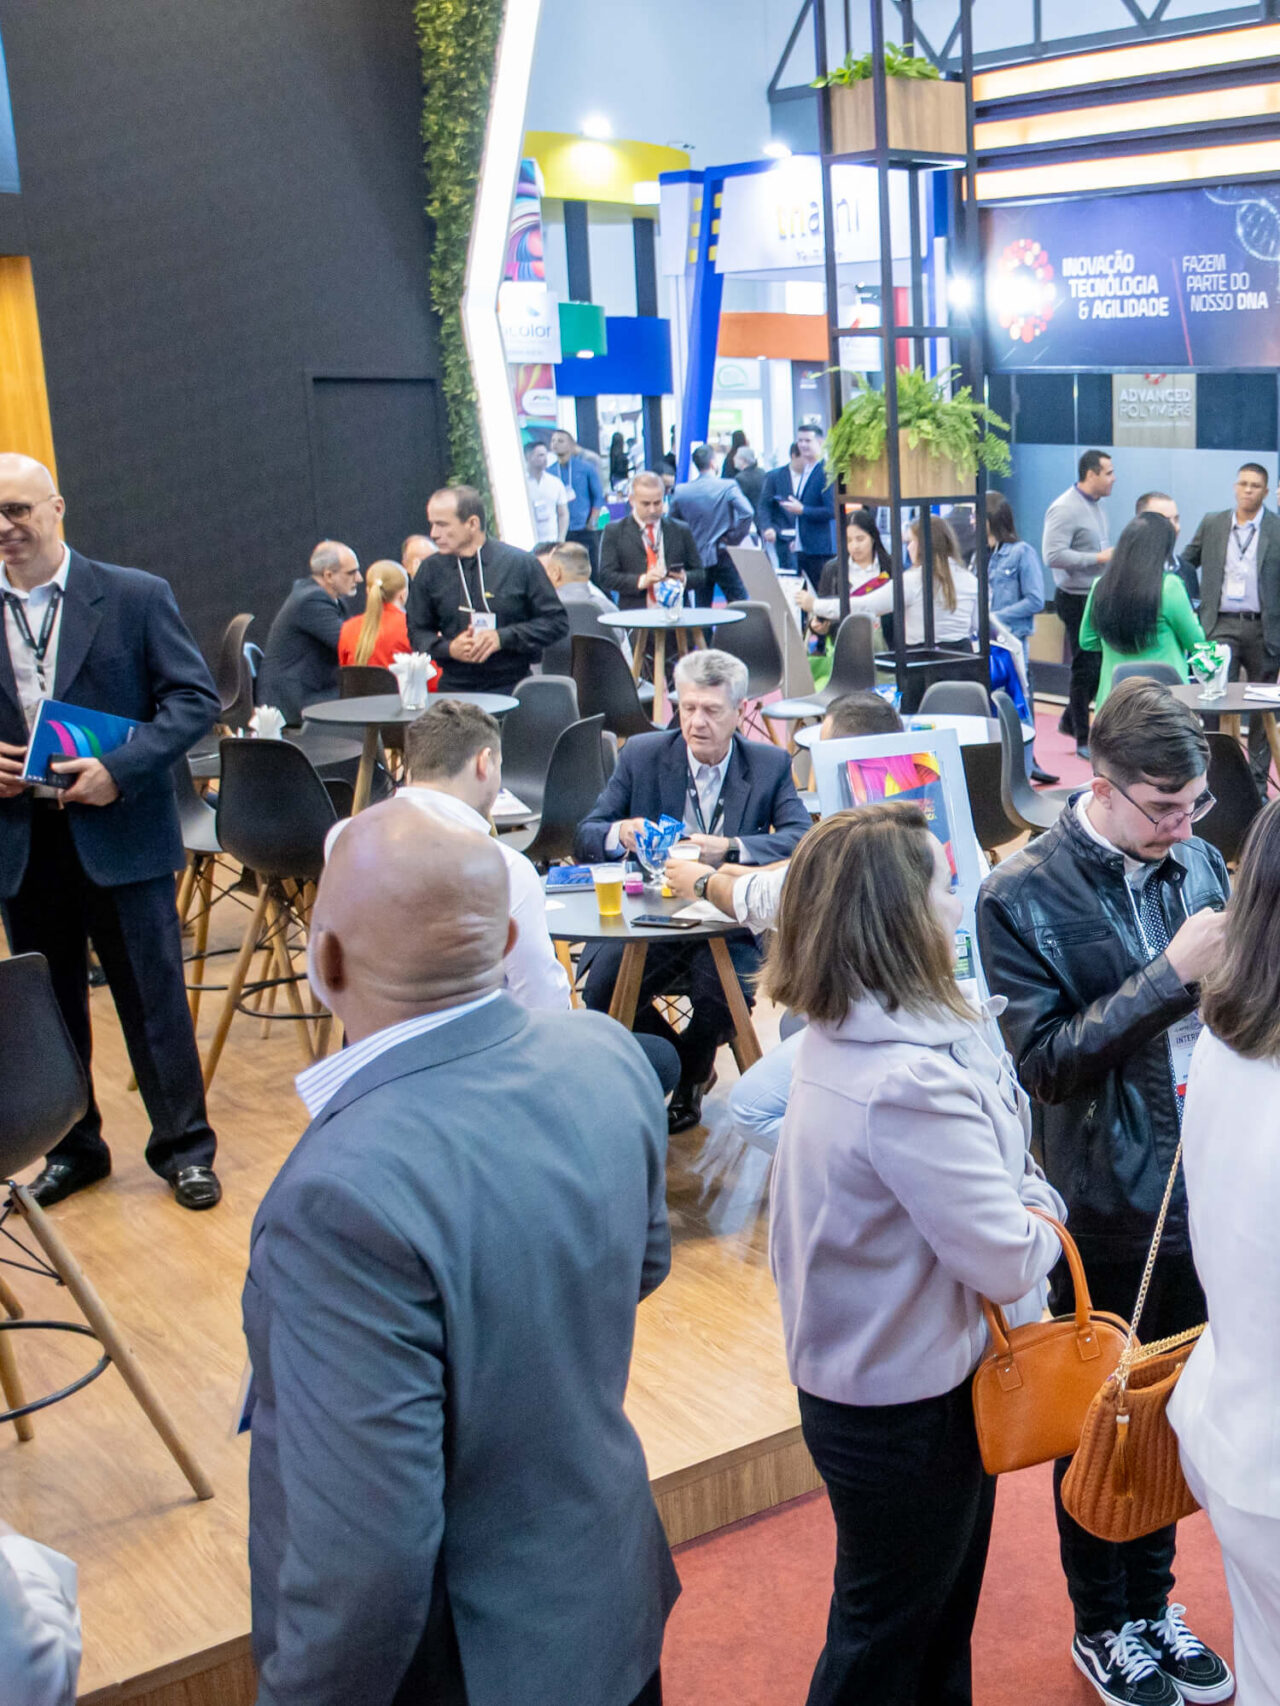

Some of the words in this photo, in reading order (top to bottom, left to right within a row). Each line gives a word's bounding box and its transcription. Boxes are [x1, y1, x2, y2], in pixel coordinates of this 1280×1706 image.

[1062, 250, 1134, 277] INOVAÇÃO
[1182, 254, 1226, 273] FAZEM
[1069, 275, 1159, 298] TECNOLOGIA
[1186, 273, 1227, 292] PARTE
[1230, 272, 1249, 291] DO
[1078, 303, 1089, 320] &
[1092, 296, 1169, 319] AGILIDADE
[1190, 293, 1233, 312] NOSSO
[1237, 291, 1269, 310] DNA
[1120, 388, 1192, 403] ADVANCED
[1120, 404, 1192, 418] POLYMERS
